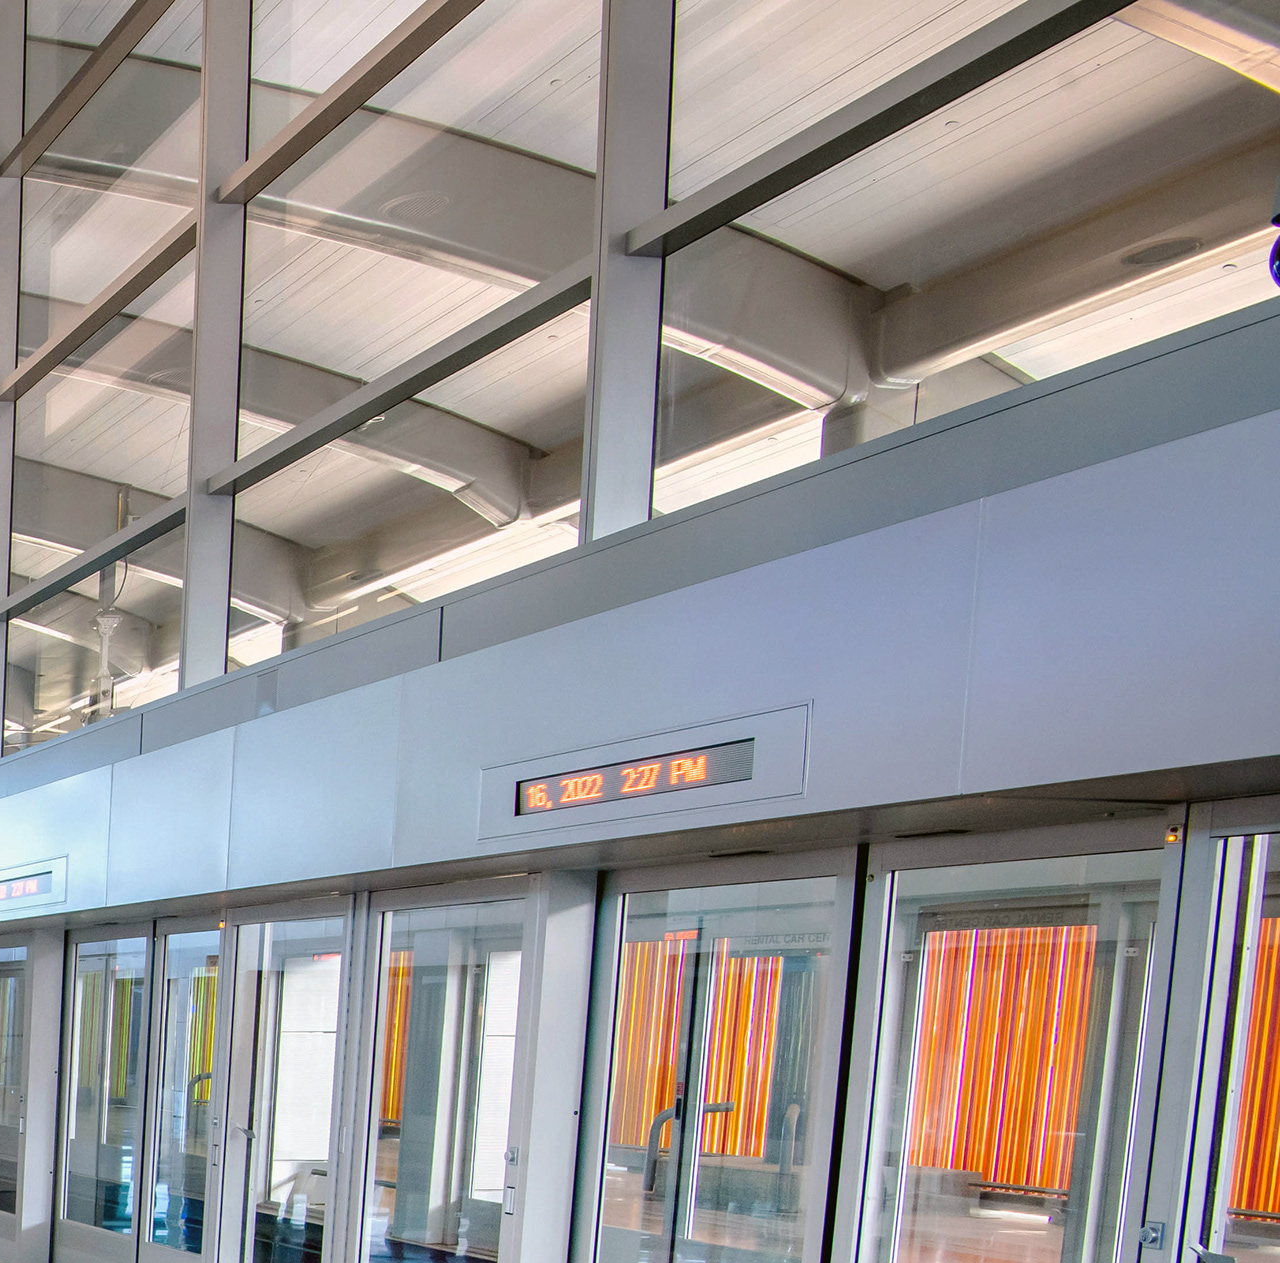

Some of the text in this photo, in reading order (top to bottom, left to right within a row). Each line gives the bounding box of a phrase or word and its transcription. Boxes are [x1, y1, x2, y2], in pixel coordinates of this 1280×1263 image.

[526, 783, 553, 809] 16,
[560, 773, 603, 803] 2022
[669, 755, 707, 785] PM
[783, 935, 807, 944] CAR
